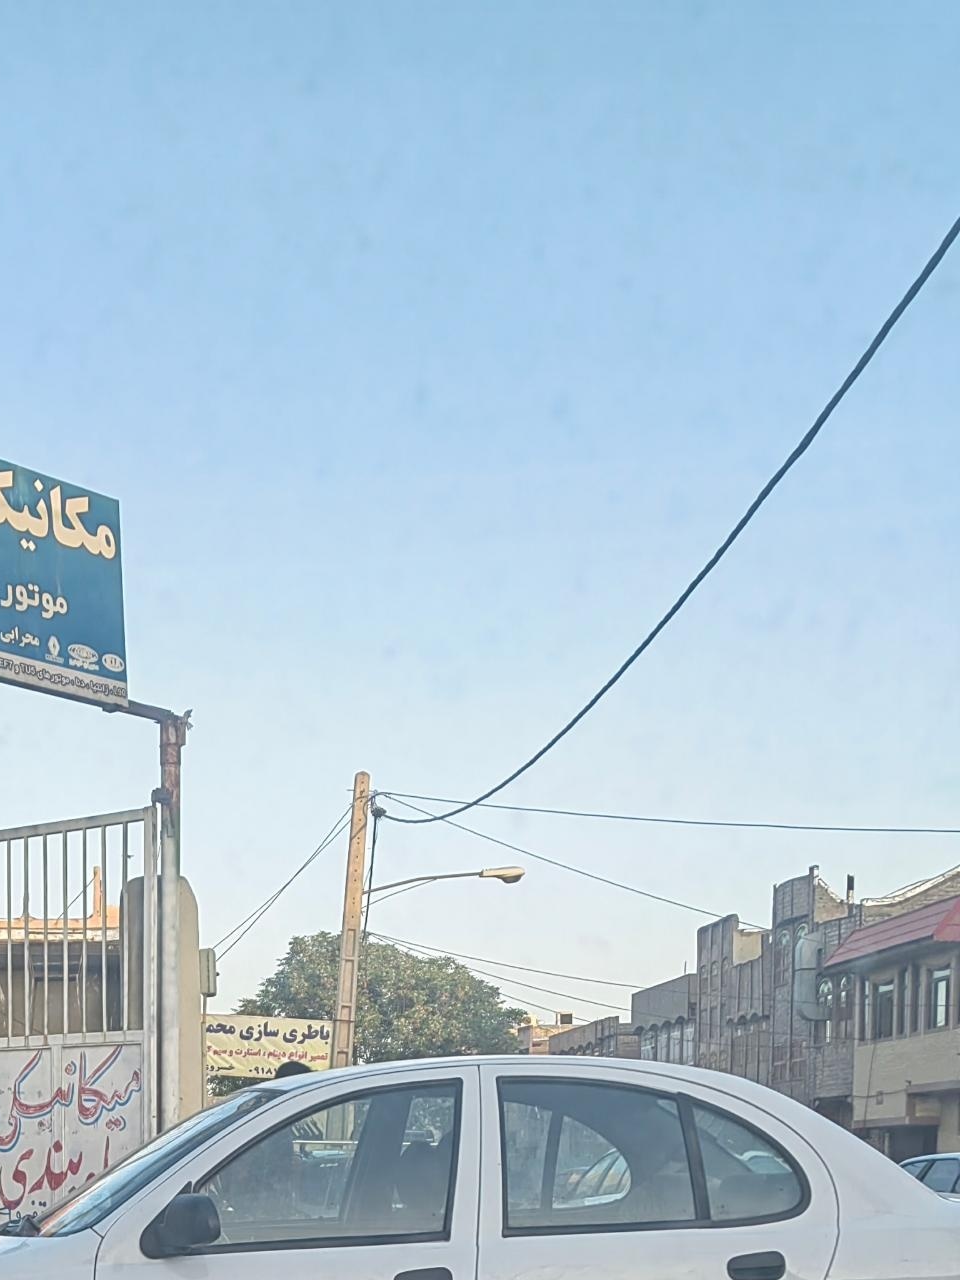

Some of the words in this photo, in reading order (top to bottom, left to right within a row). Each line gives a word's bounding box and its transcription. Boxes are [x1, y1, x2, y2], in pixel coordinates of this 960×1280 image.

[0, 583, 69, 619] موتور
[0, 626, 40, 648] محرابی
[206, 1022, 236, 1034] محم
[240, 1021, 280, 1042] سازی
[283, 1023, 330, 1045] باطری
[235, 1048, 260, 1058] استارت
[288, 1050, 308, 1061] انواع
[309, 1053, 329, 1062] تعمیر
